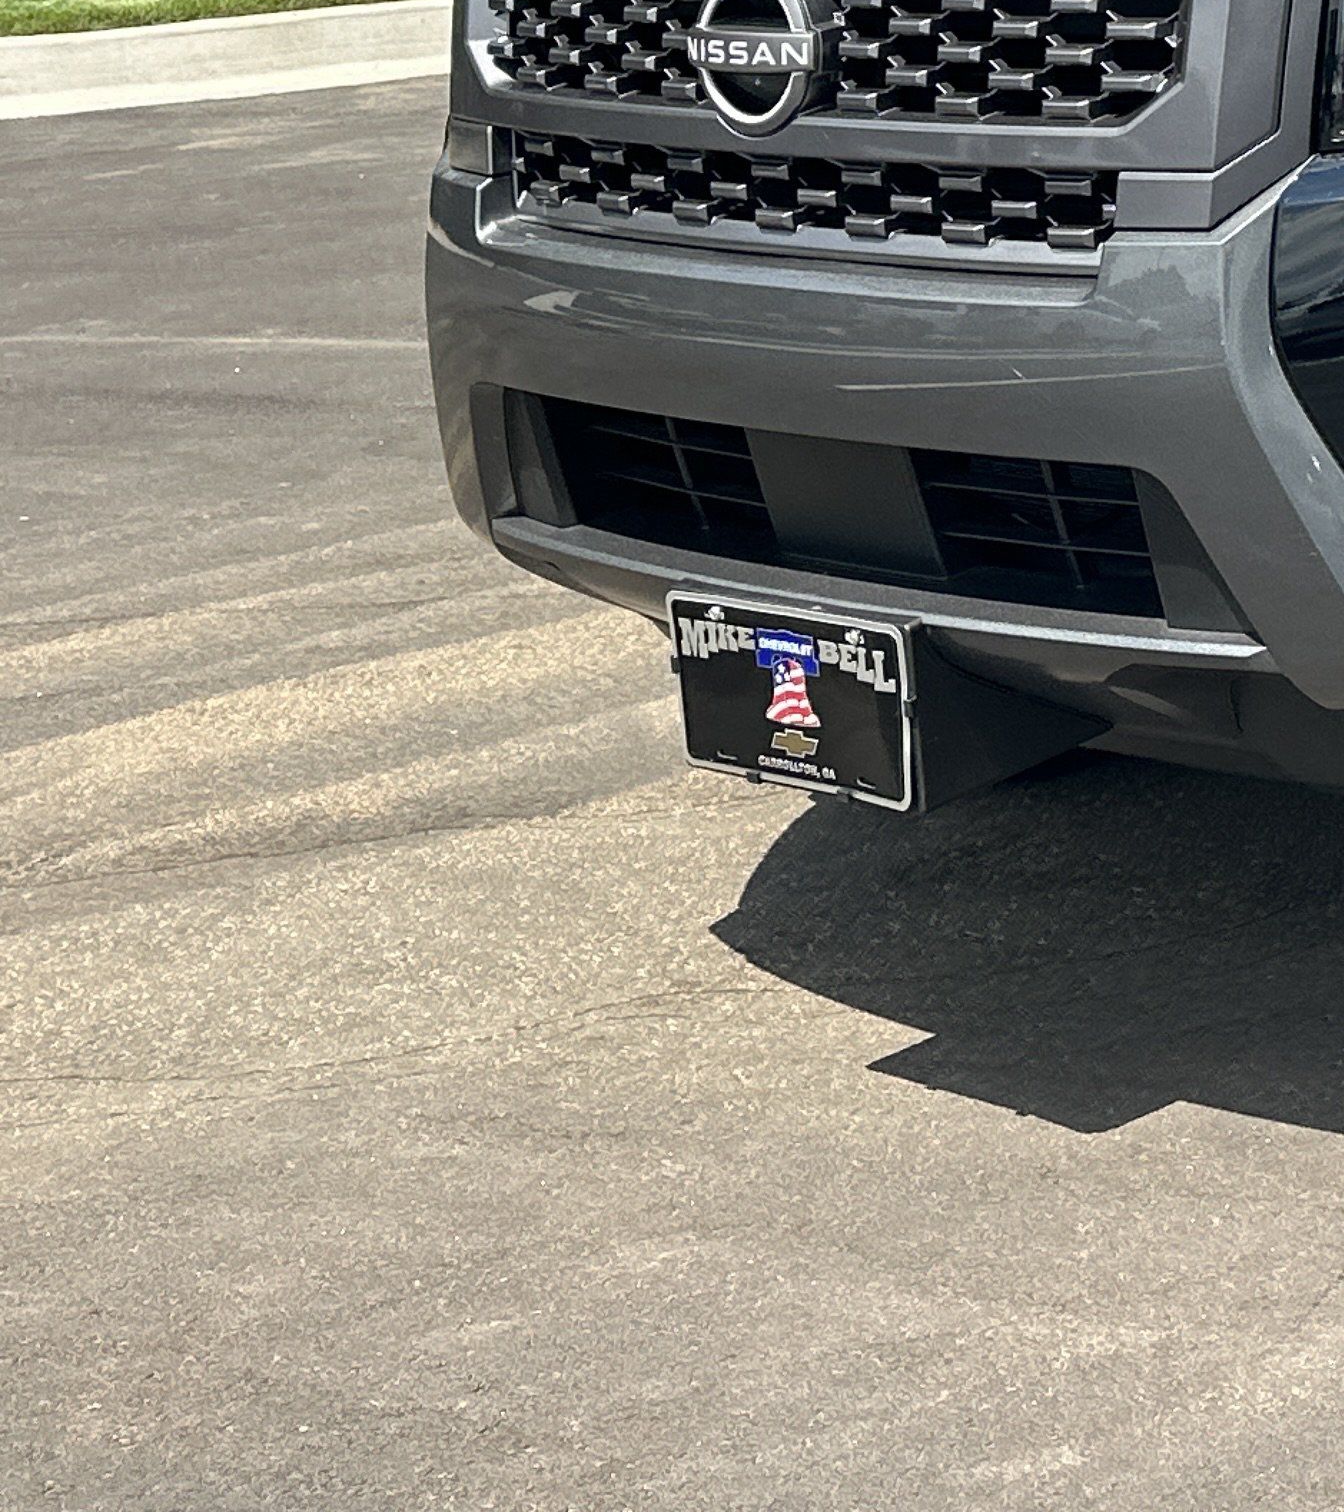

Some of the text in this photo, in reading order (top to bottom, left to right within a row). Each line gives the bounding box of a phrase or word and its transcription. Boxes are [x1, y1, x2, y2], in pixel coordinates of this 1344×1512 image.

[687, 36, 808, 65] NISSAN
[678, 617, 756, 659] MIKE
[817, 639, 896, 693] BELL
